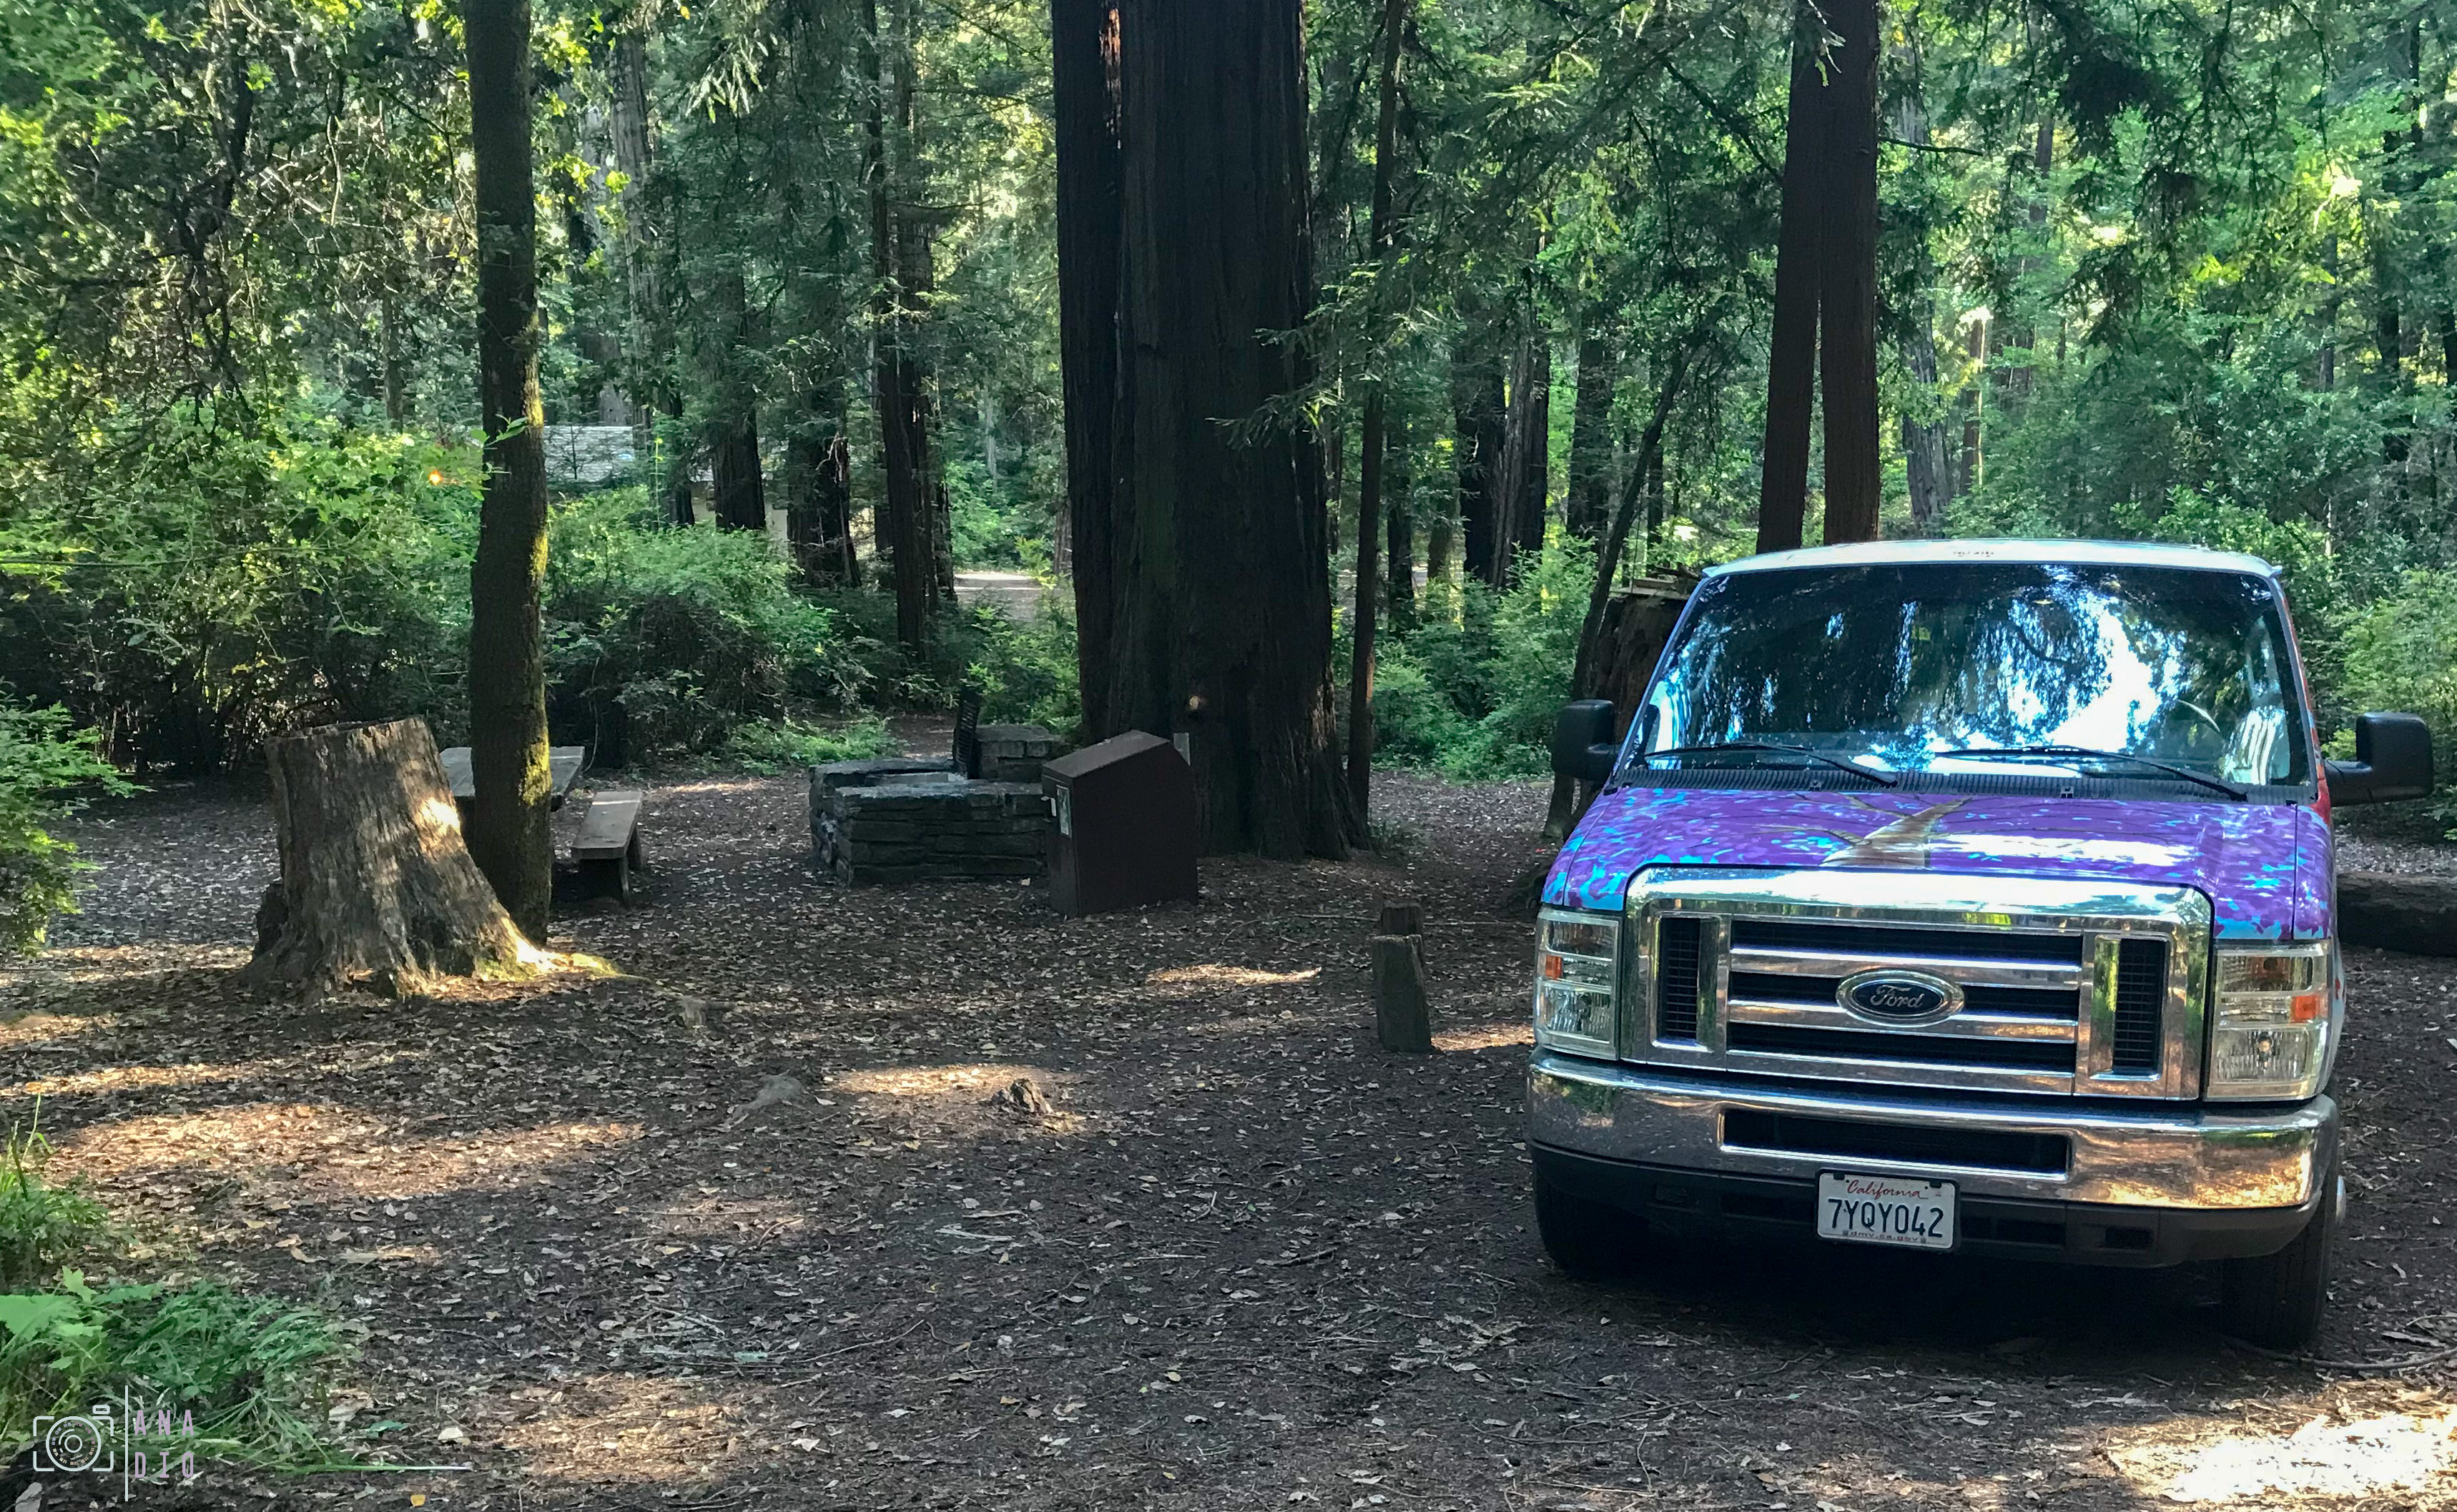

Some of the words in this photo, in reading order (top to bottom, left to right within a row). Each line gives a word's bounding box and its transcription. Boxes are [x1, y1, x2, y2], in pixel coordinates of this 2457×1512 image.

[1869, 984, 1925, 1009] Ford
[1847, 1179, 1929, 1200] California
[1828, 1198, 1944, 1238] 7YQY042
